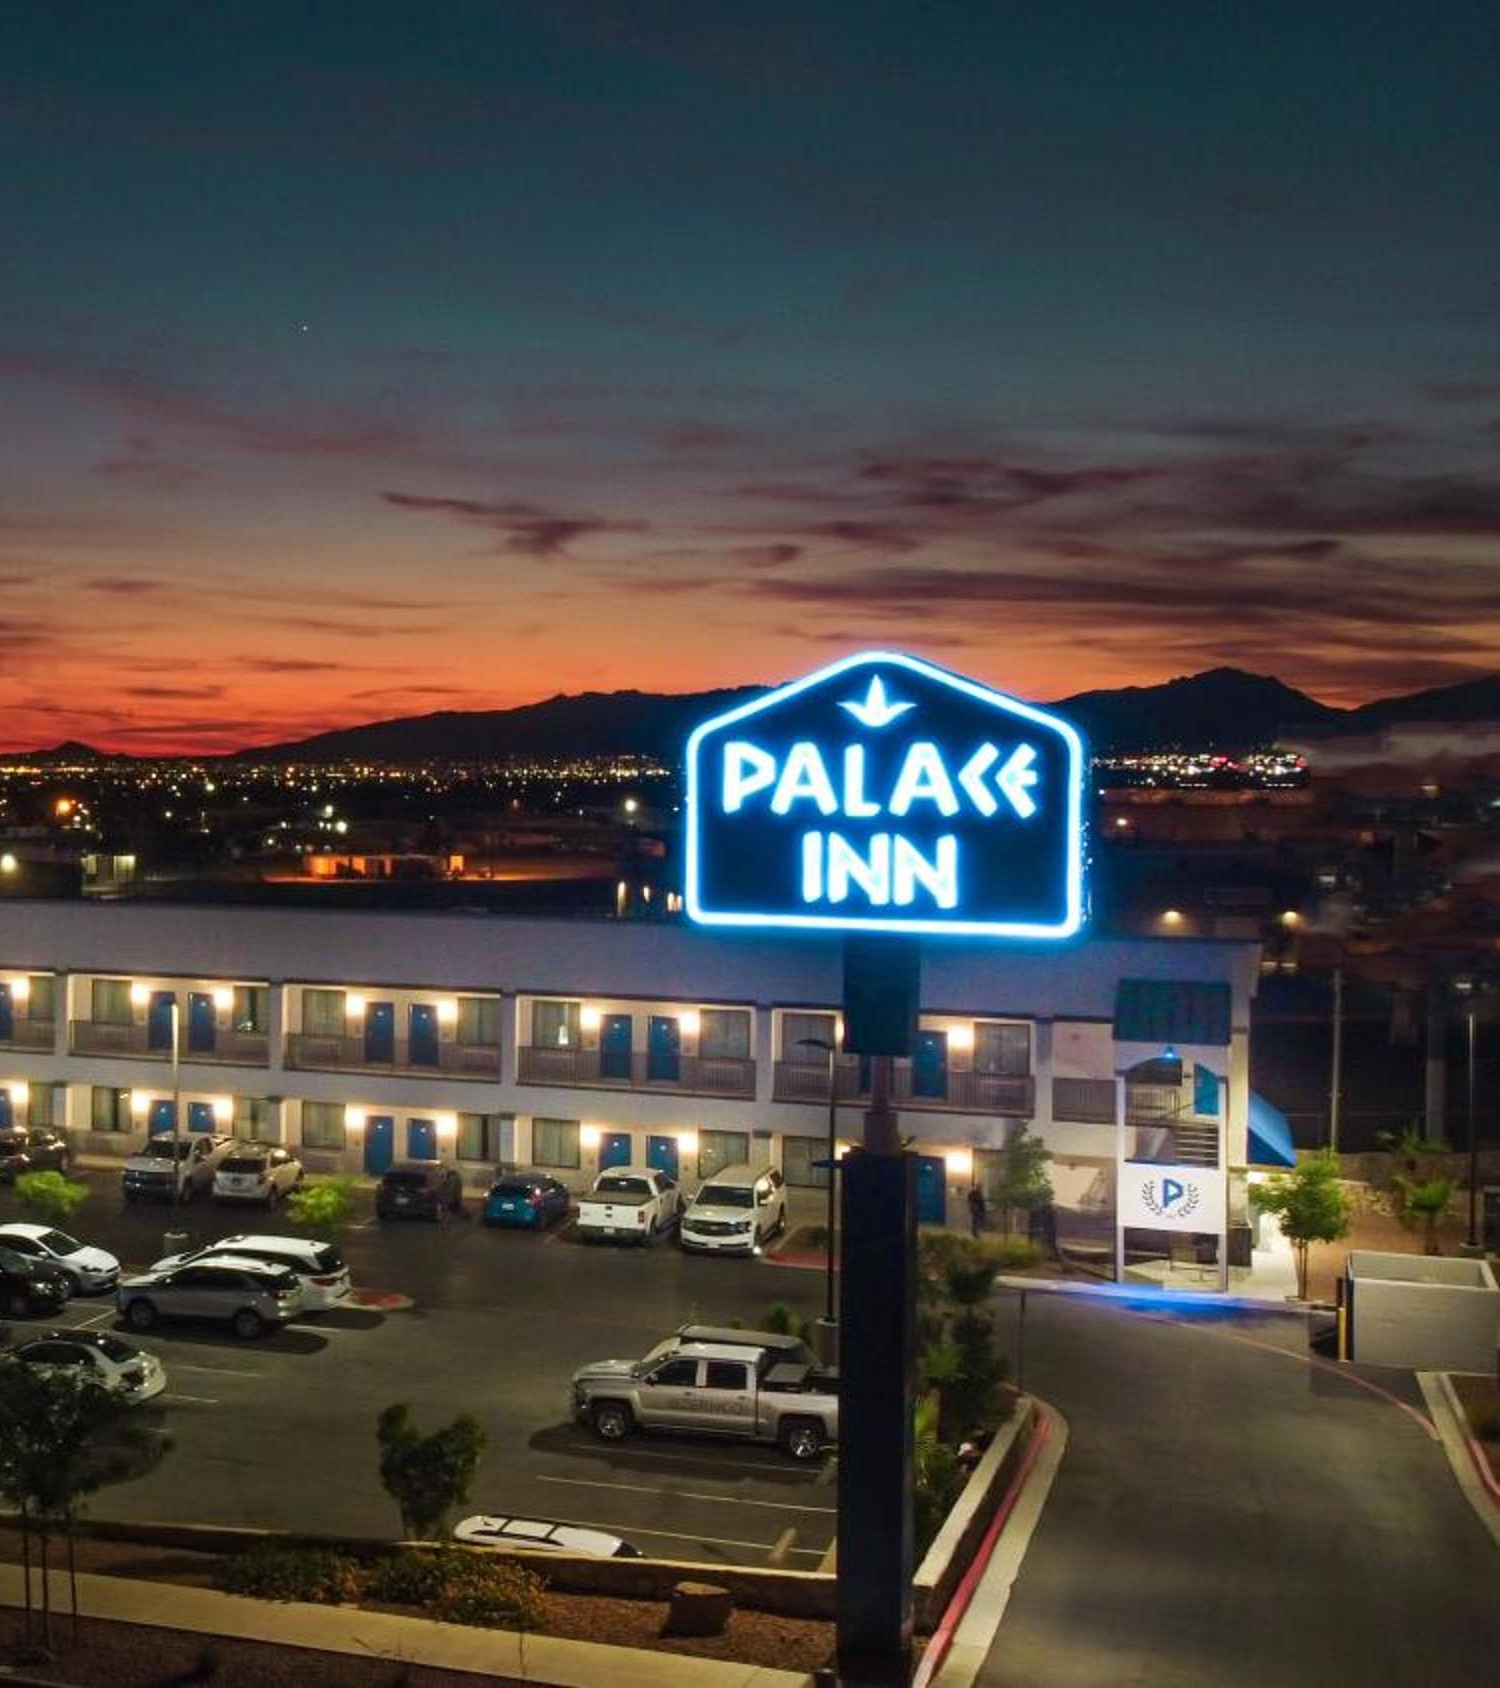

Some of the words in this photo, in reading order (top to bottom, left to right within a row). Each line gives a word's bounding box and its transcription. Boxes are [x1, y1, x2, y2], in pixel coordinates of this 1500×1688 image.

[722, 740, 1038, 820] PALACE
[802, 830, 958, 910] INN
[1162, 1179, 1184, 1208] P
